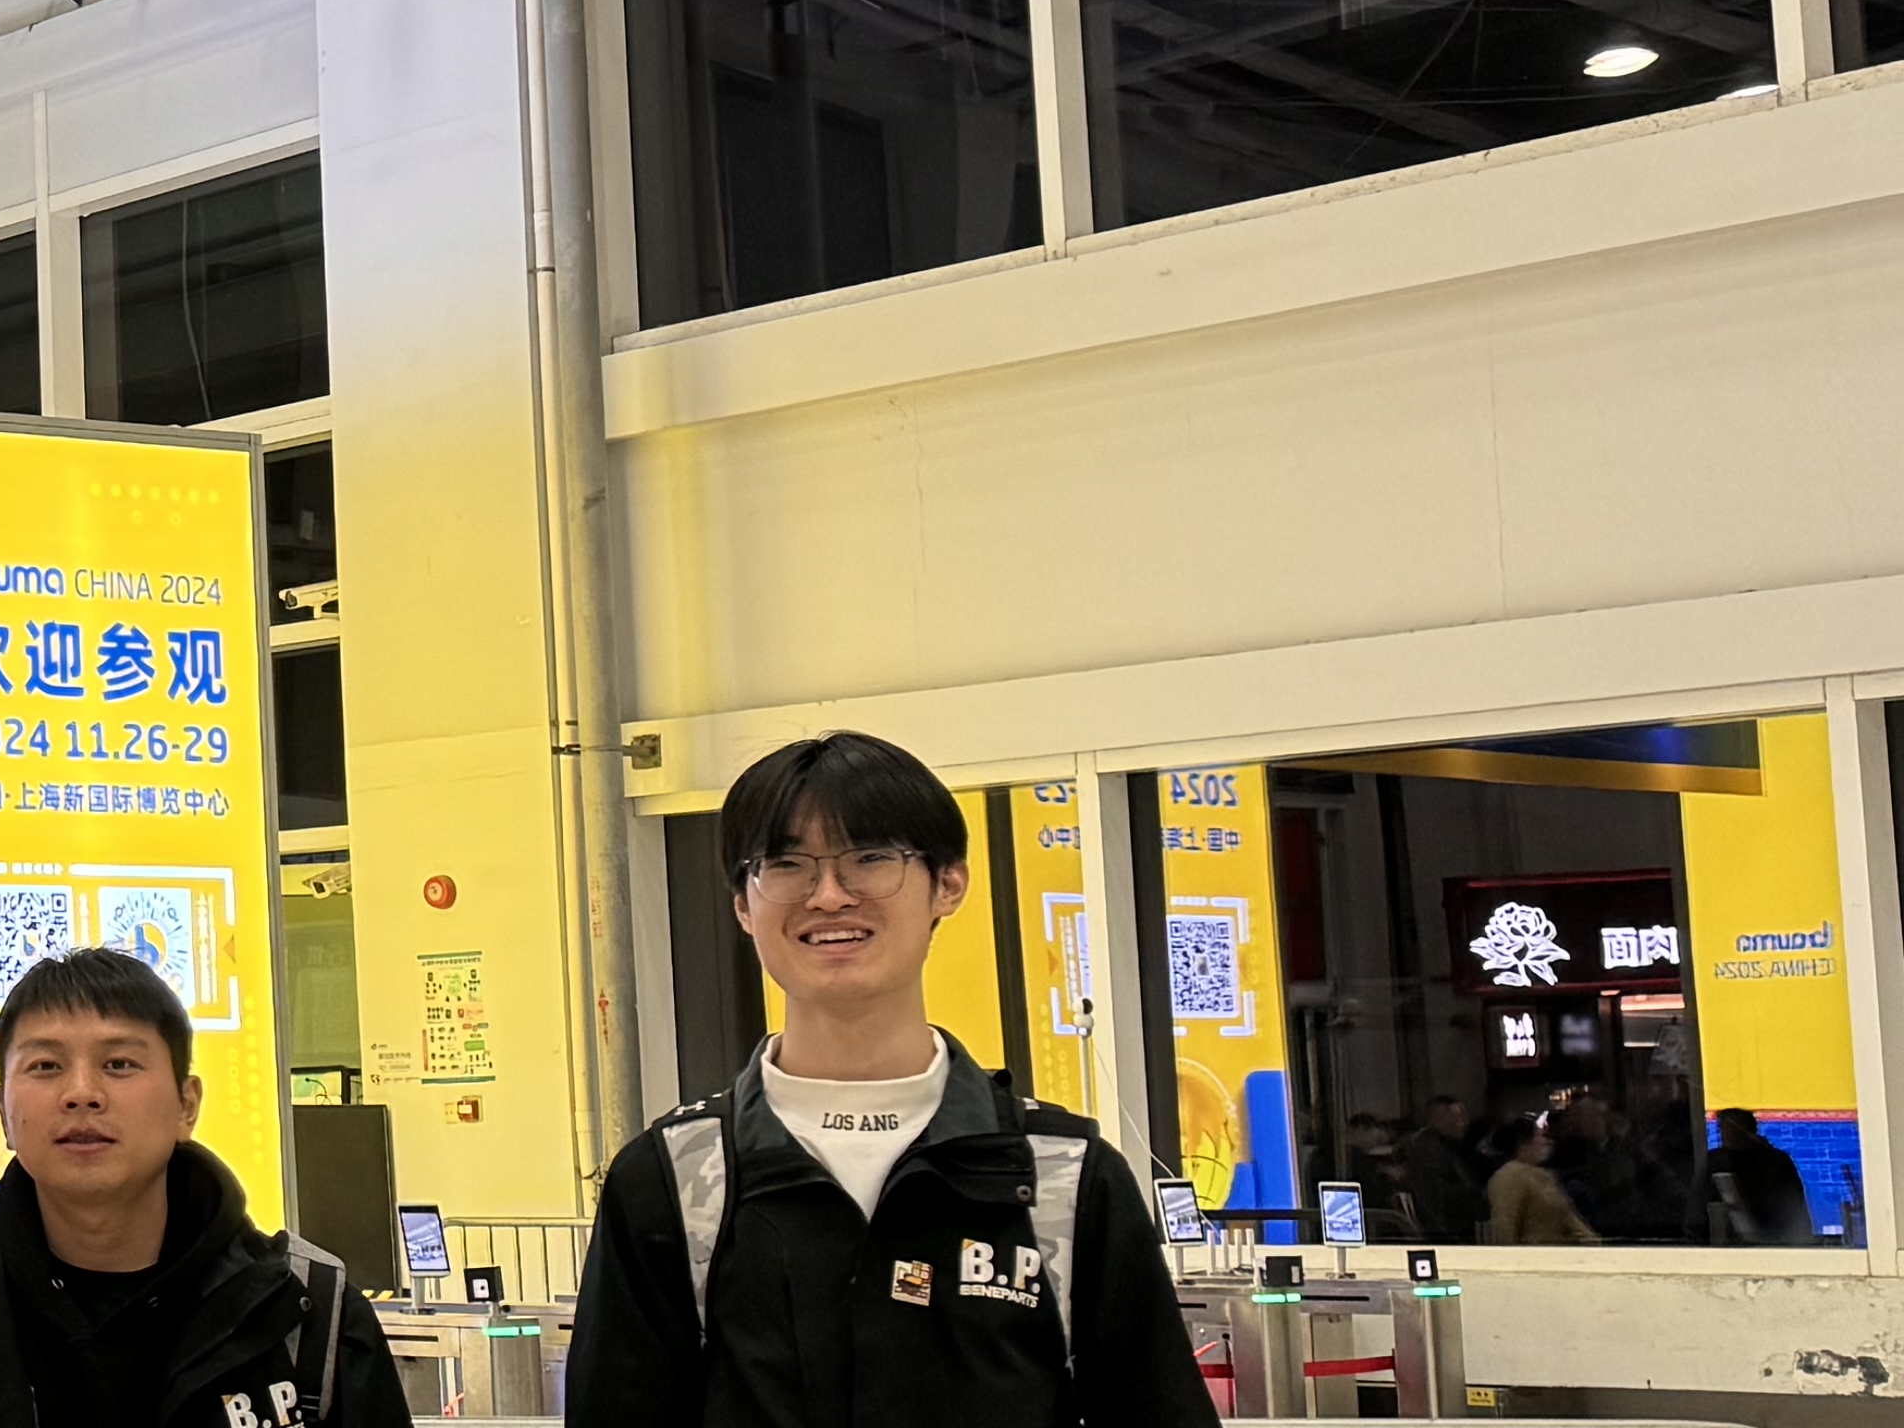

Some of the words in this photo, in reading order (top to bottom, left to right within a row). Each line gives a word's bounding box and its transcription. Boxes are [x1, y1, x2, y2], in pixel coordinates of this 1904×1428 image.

[75, 569, 153, 601] CHINA
[160, 575, 223, 606] 2024
[65, 721, 229, 765] 11.26-29
[822, 1112, 854, 1131] LOS
[859, 1113, 899, 1132] ANG
[960, 1238, 1041, 1294] B.P.
[959, 1283, 1039, 1308] BENEPARTS
